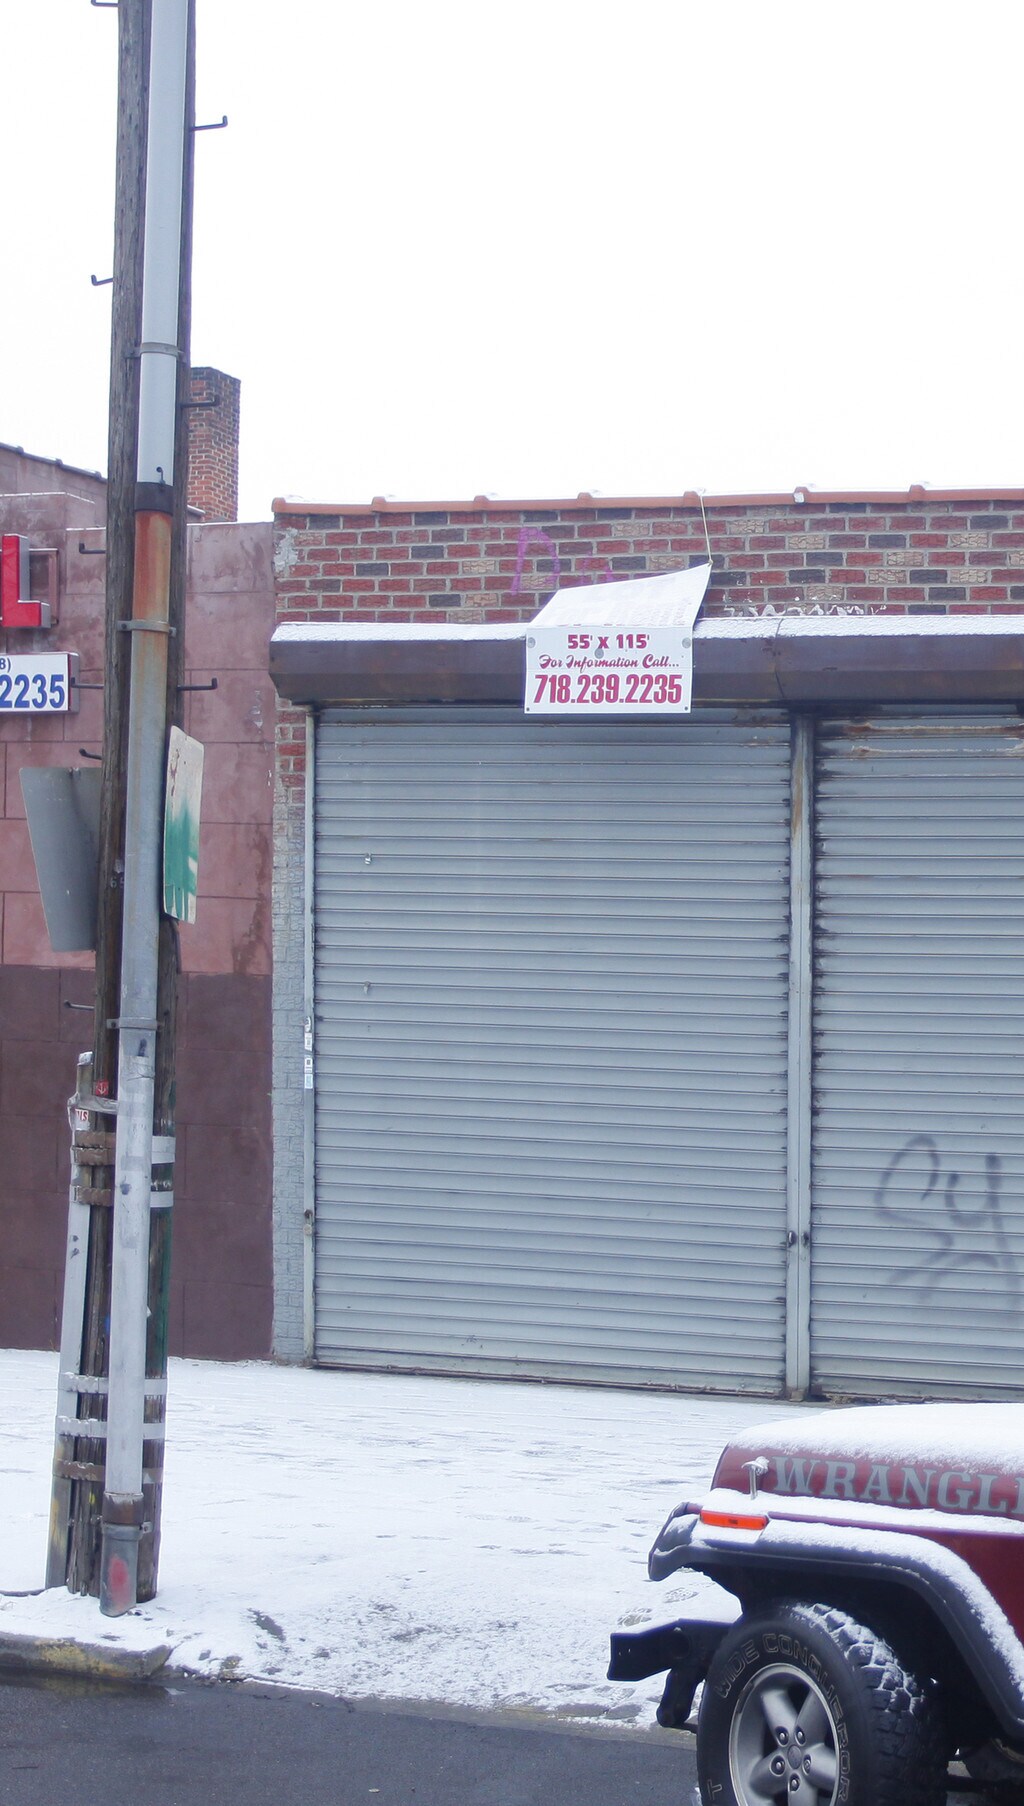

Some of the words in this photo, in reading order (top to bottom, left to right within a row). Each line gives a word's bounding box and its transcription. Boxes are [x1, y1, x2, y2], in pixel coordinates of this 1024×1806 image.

[567, 633, 593, 650] 55'
[616, 633, 650, 650] 115'
[538, 654, 563, 670] For
[565, 654, 639, 674] Information
[641, 653, 680, 669] Call...
[0, 673, 65, 709] 2235
[533, 673, 683, 704] 718.239.2235
[714, 1639, 760, 1700] WIDE
[762, 1632, 850, 1803] CONQUEROR
